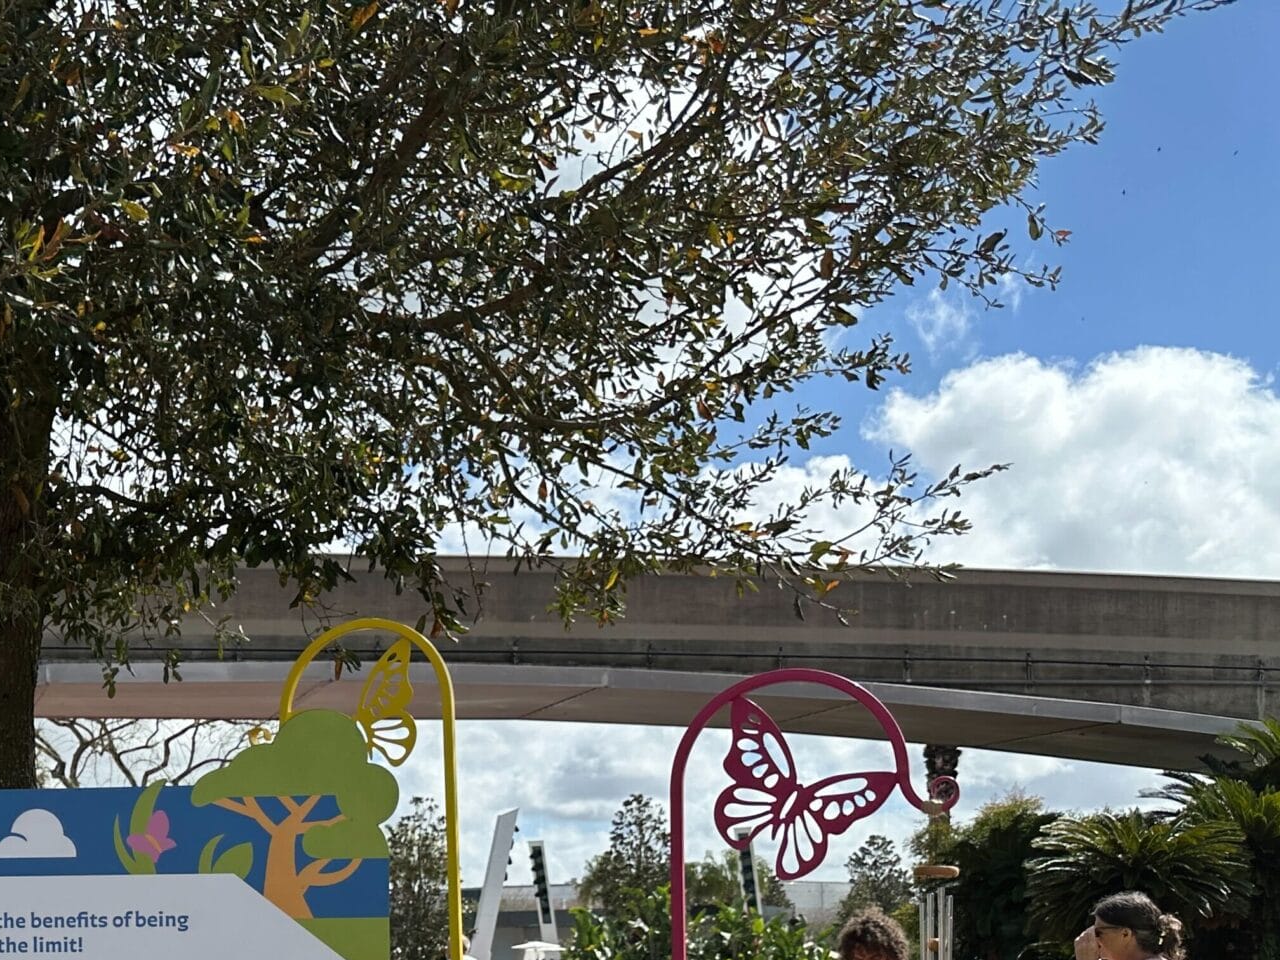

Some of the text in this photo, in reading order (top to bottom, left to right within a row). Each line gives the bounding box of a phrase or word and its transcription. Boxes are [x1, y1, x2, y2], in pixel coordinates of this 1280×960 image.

[30, 911, 108, 929] benefits
[112, 910, 134, 928] of
[135, 910, 190, 932] being
[33, 936, 83, 953] limit!
